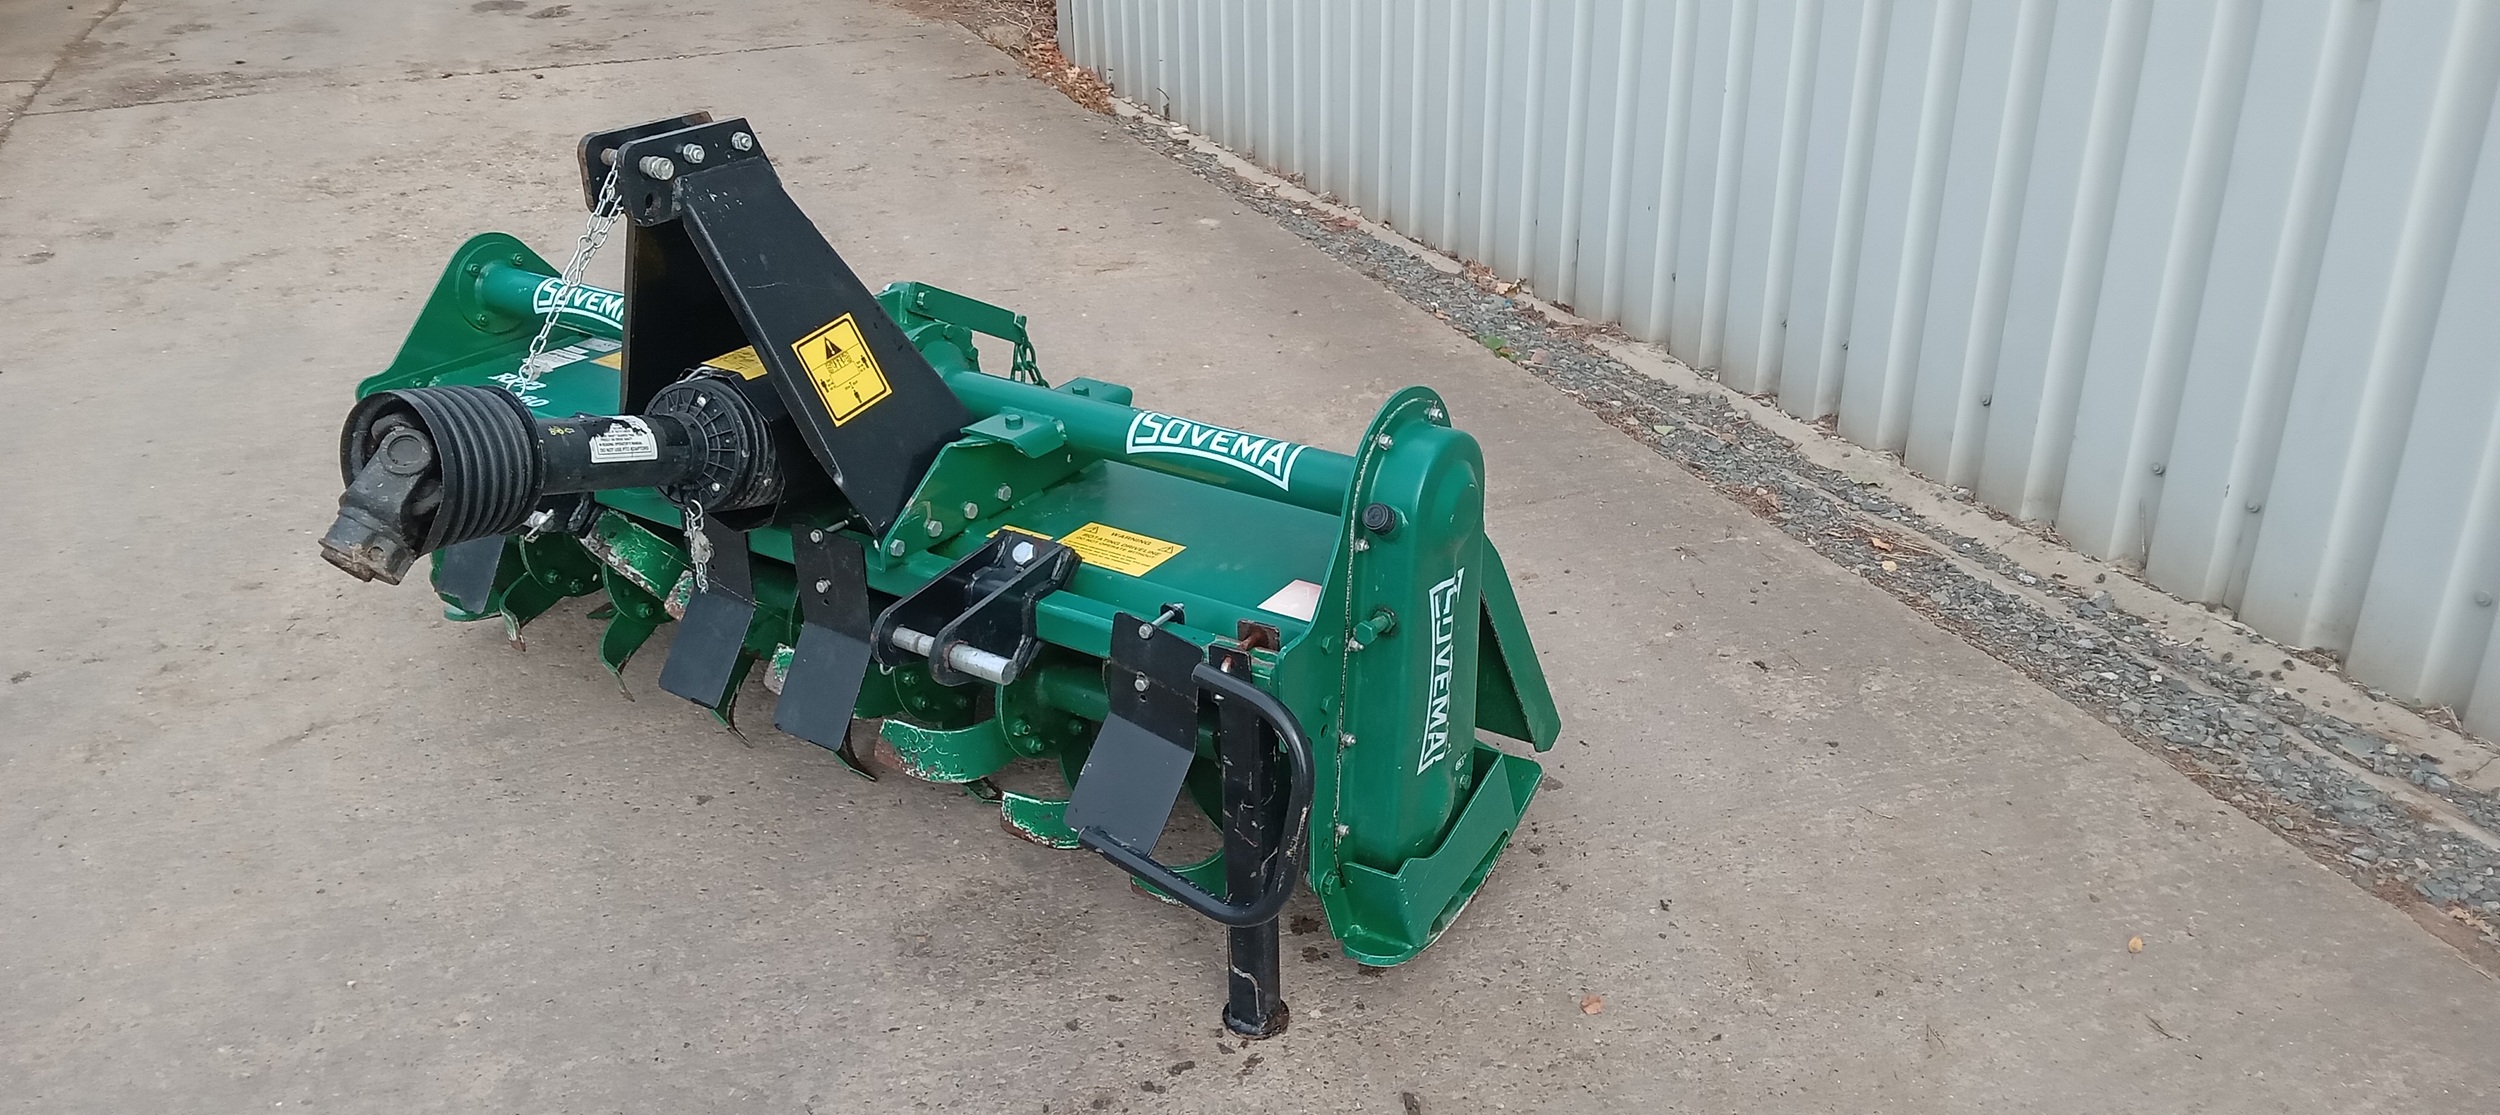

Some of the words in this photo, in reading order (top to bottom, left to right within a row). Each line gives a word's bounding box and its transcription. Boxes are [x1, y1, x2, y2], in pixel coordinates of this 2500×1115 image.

[538, 279, 624, 321] SVEM
[1135, 411, 1290, 477] SOVEMA
[1082, 533, 1121, 547] ROTATING
[1120, 543, 1161, 556] DRIVELINE
[1098, 541, 1128, 552] OPERATE
[1111, 531, 1152, 546] WARNING
